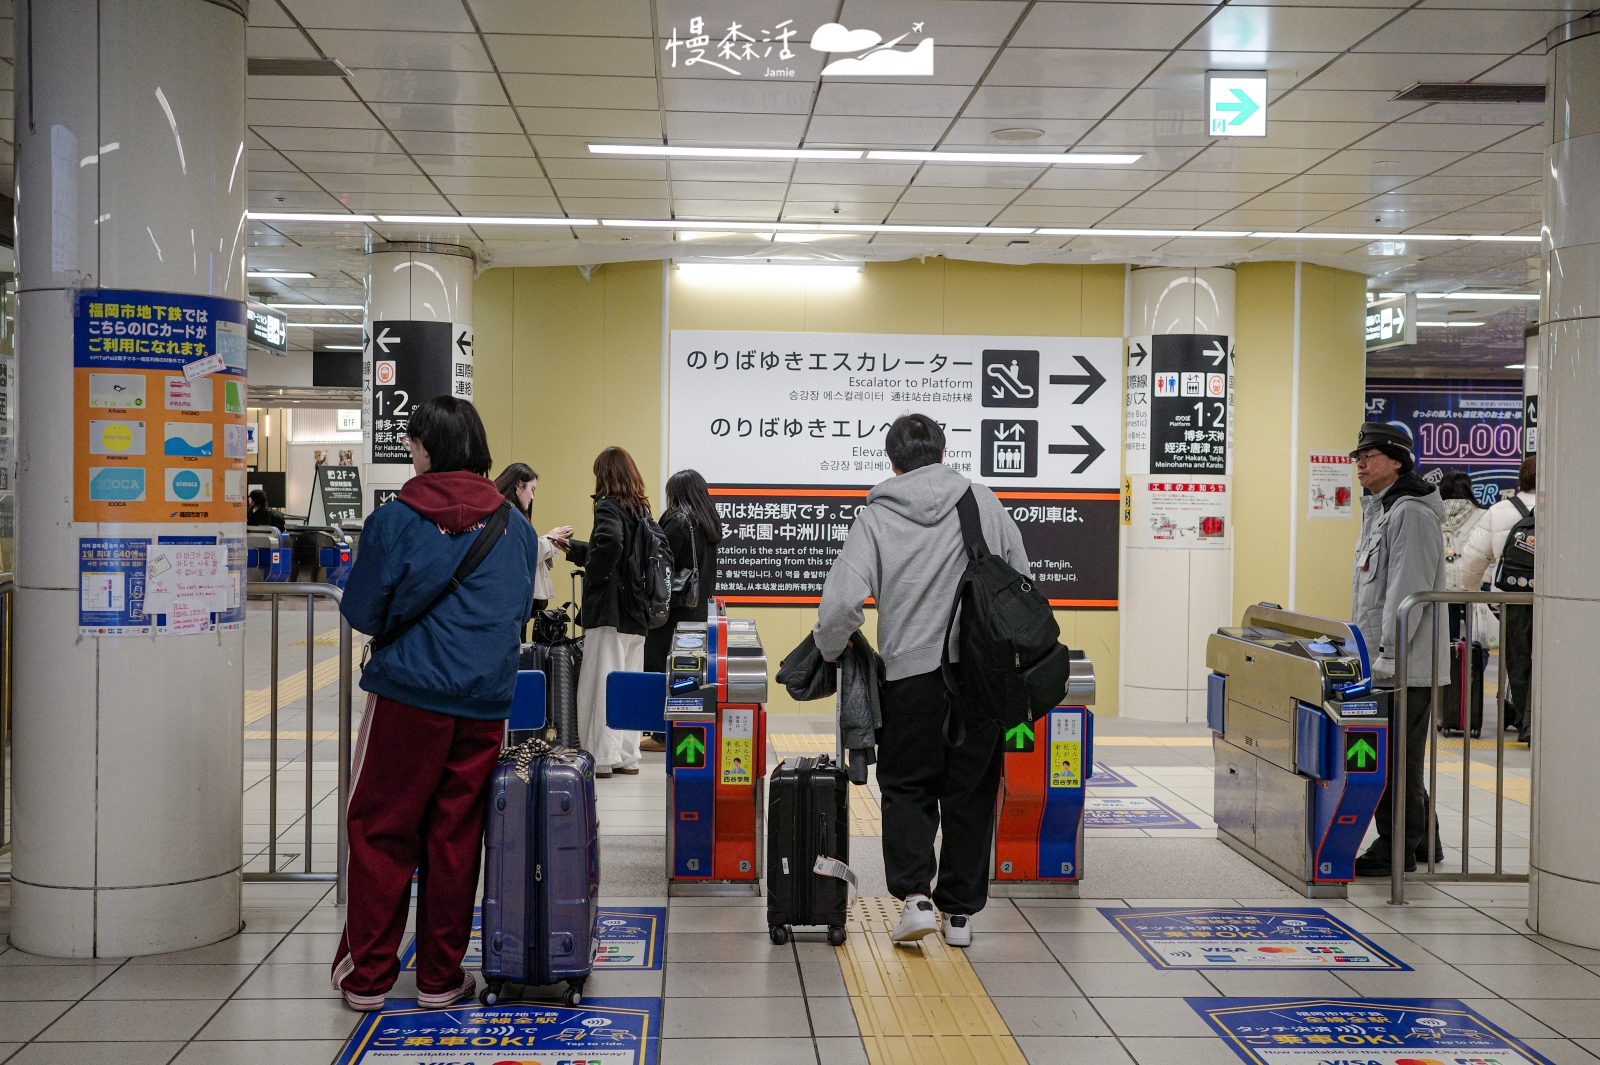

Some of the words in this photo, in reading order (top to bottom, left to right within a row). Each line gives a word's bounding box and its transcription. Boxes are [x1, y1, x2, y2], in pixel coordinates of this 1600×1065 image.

[89, 303, 208, 323] 福岡市地下鉄では
[89, 321, 207, 339] こちらのICカードが
[88, 337, 209, 357] ご利用になれます。
[687, 349, 973, 374] のりばゆきエスカレーター
[455, 380, 473, 395] 連絡
[849, 376, 901, 389] Escalator
[905, 378, 918, 389] to
[921, 377, 973, 389] Platform
[789, 390, 820, 402] 승강장
[823, 390, 885, 402] 에스컬레이터
[891, 391, 973, 403] 通往站台自动扶梯
[1365, 398, 1385, 410] JR
[343, 418, 355, 427] B1F
[1184, 430, 1225, 442] 博多・天神
[1164, 442, 1211, 454] 姪浜・唐津
[1213, 446, 1224, 454] 方面
[820, 460, 850, 472] 승강장
[336, 471, 348, 480] 2F
[1152, 483, 1224, 492] 工事のお知らせ
[337, 511, 348, 519] 1F
[717, 546, 748, 555] station
[750, 546, 757, 555] is
[759, 546, 774, 555] the
[775, 546, 795, 555] start
[797, 546, 807, 555] of
[809, 546, 824, 555] the
[739, 556, 782, 566] departing
[784, 556, 805, 565] from
[808, 556, 823, 565] this
[1044, 560, 1073, 570] Tenjin.
[725, 569, 773, 579] 출발역입니다.
[775, 570, 783, 578] 이
[785, 570, 800, 579] 역을
[1039, 573, 1079, 582] 정차합니다.
[735, 741, 741, 754] 私が
[1063, 744, 1070, 757] 私が
[467, 1017, 557, 1025] 全線全駅
[382, 1027, 481, 1035] タッチ決済
[373, 1036, 535, 1047] ご乗車OK!
[1245, 1034, 1404, 1044] ご乗車OK!
